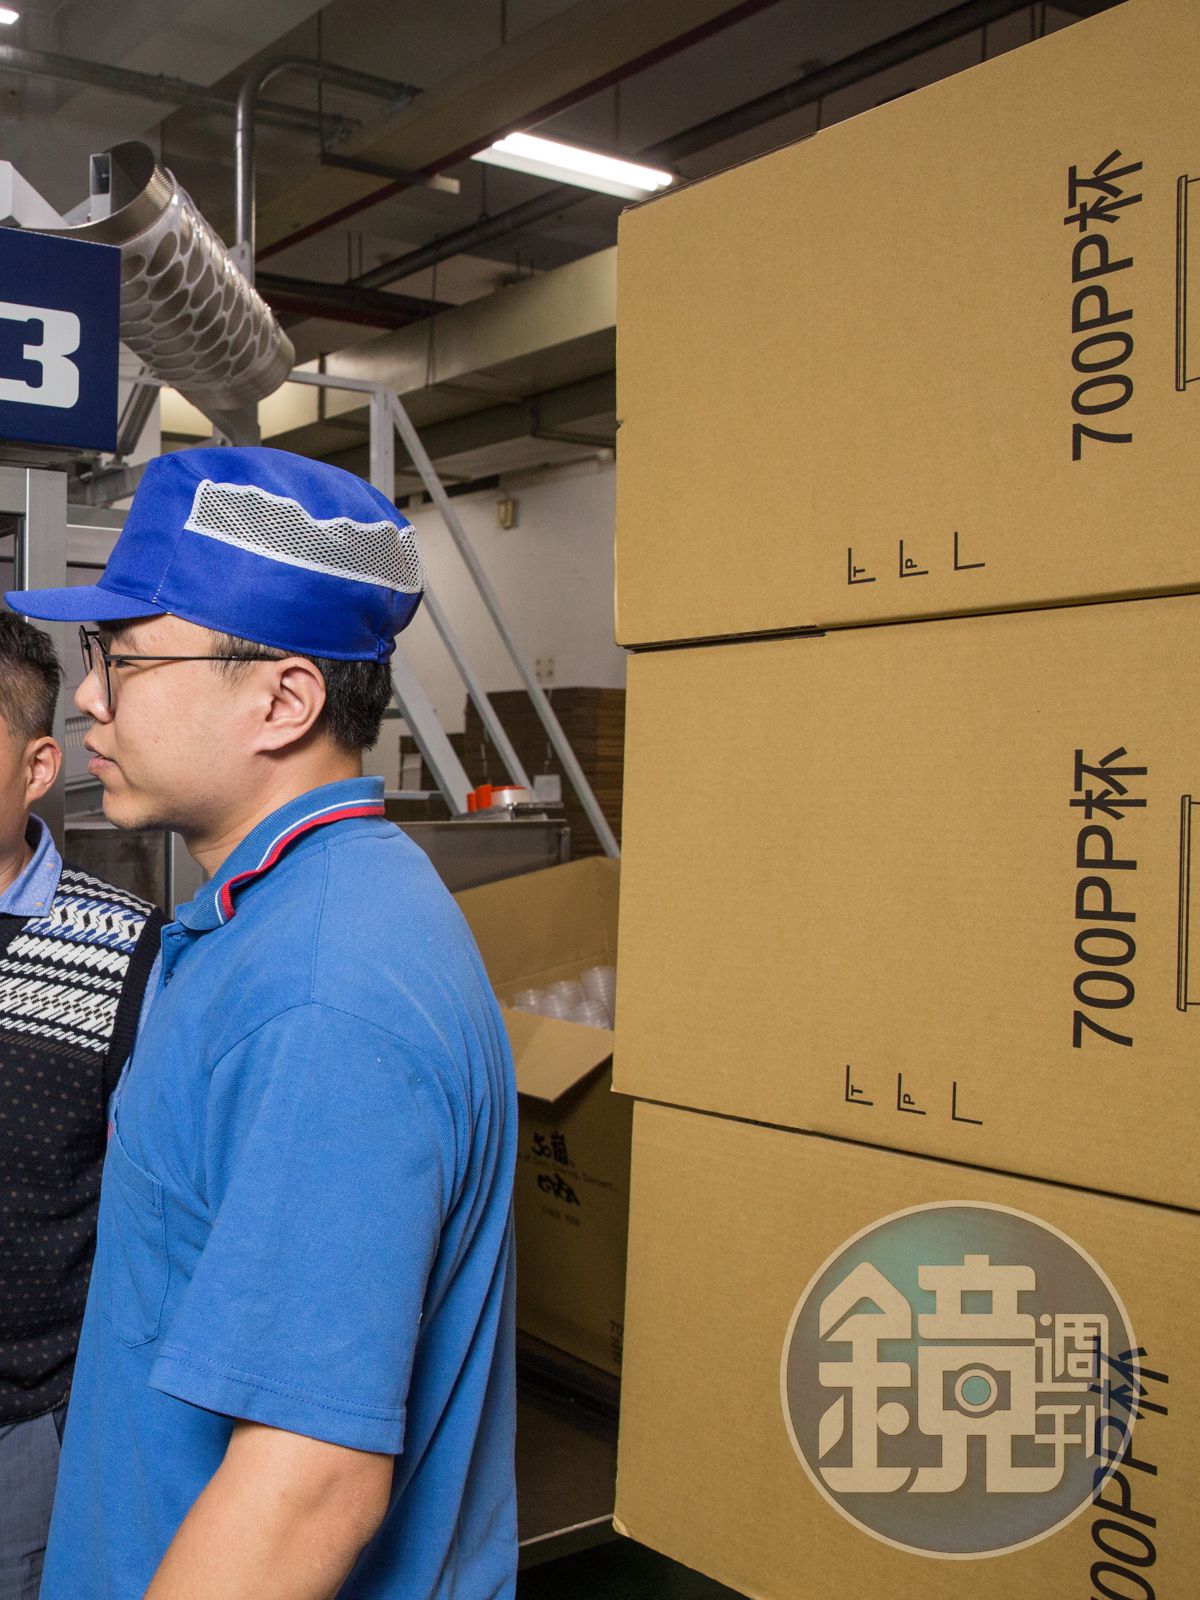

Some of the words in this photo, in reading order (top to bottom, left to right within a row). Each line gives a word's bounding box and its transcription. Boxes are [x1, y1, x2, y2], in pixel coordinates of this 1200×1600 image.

[1063, 148, 1143, 462] 700PP杯
[1069, 746, 1148, 1049] 700PP杯
[1089, 1335, 1169, 1600] 00PP杯
